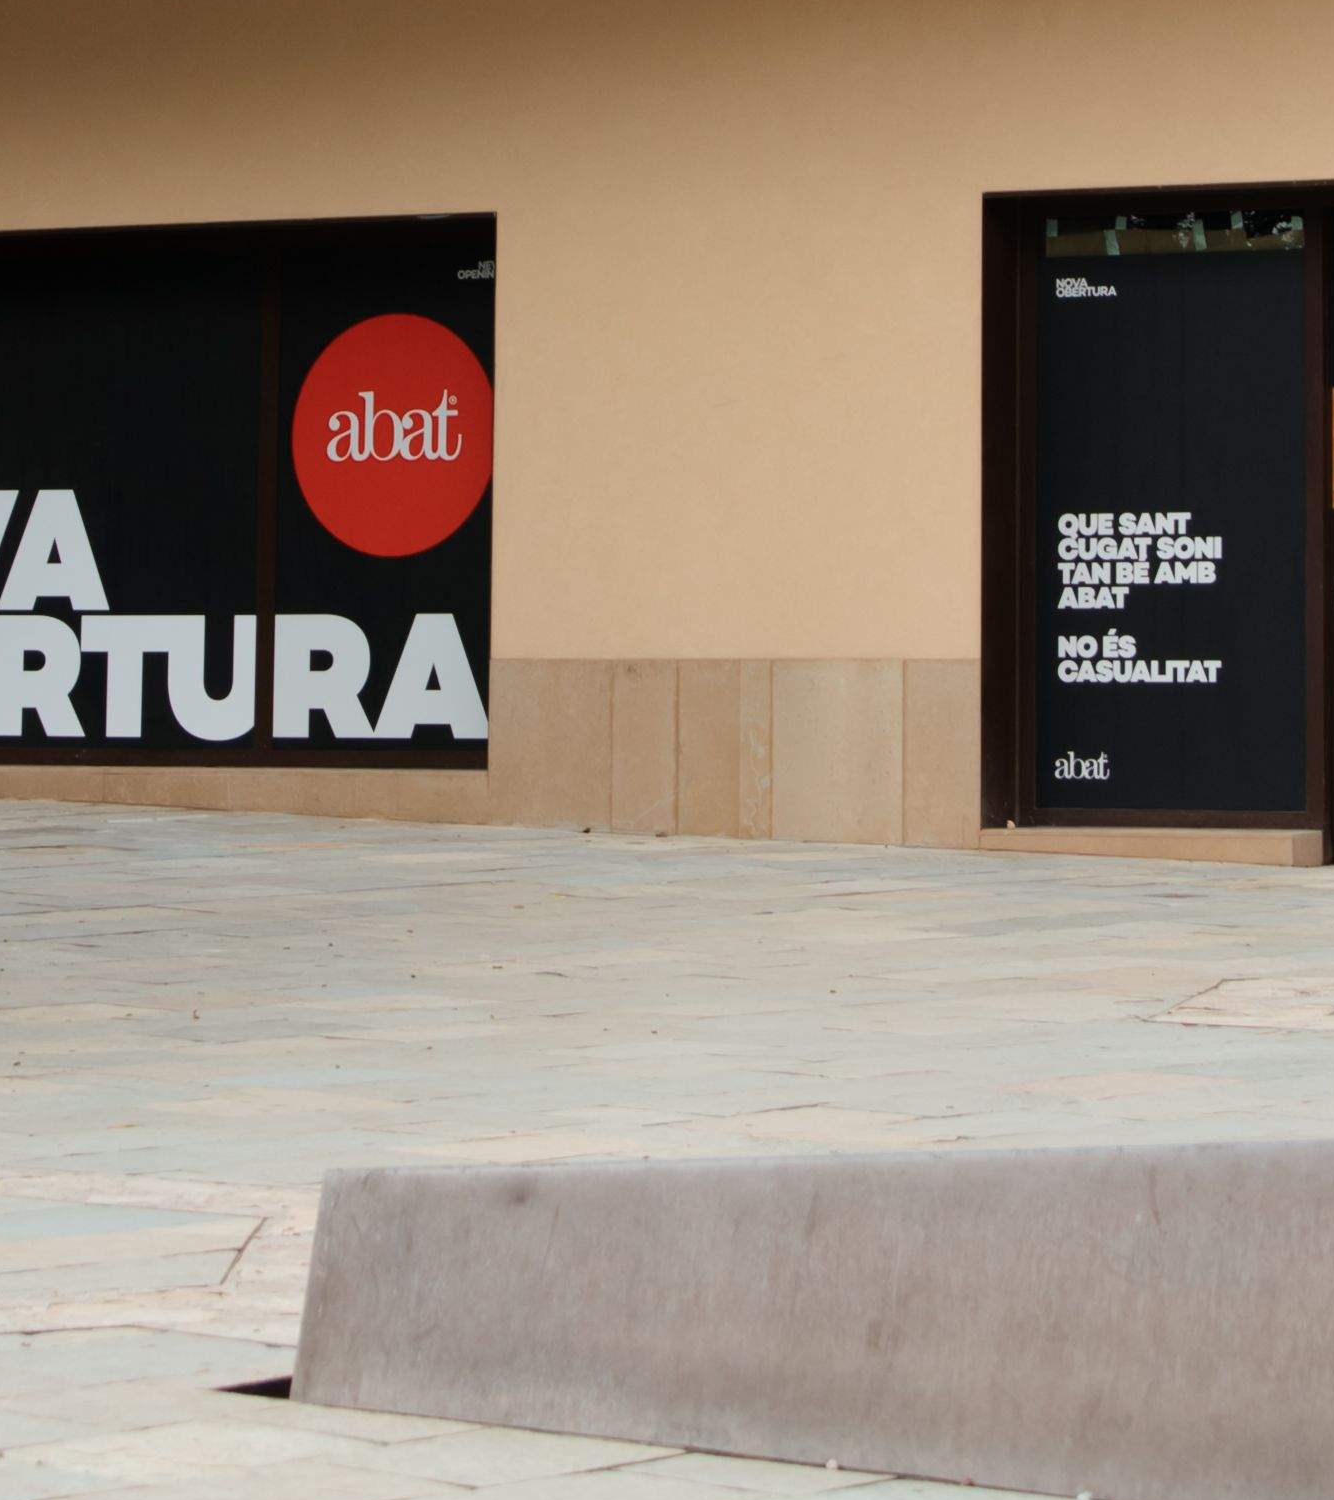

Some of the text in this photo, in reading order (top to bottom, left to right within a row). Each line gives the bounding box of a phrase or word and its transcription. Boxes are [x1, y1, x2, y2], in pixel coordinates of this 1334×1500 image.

[457, 269, 495, 280] OPENIN
[1056, 278, 1088, 288] NOVA
[1056, 286, 1117, 297] OBERTURA
[327, 389, 463, 462] abat
[1058, 512, 1192, 539] QUE SANT
[1058, 536, 1223, 561] CUGAT SONI
[1058, 562, 1111, 584] TAN
[1154, 561, 1217, 584] AMB
[1058, 586, 1129, 609] ABAT
[1058, 628, 1137, 658] NO ÉS
[1058, 660, 1223, 683] CASUALITAT
[1054, 751, 1110, 780] abat
